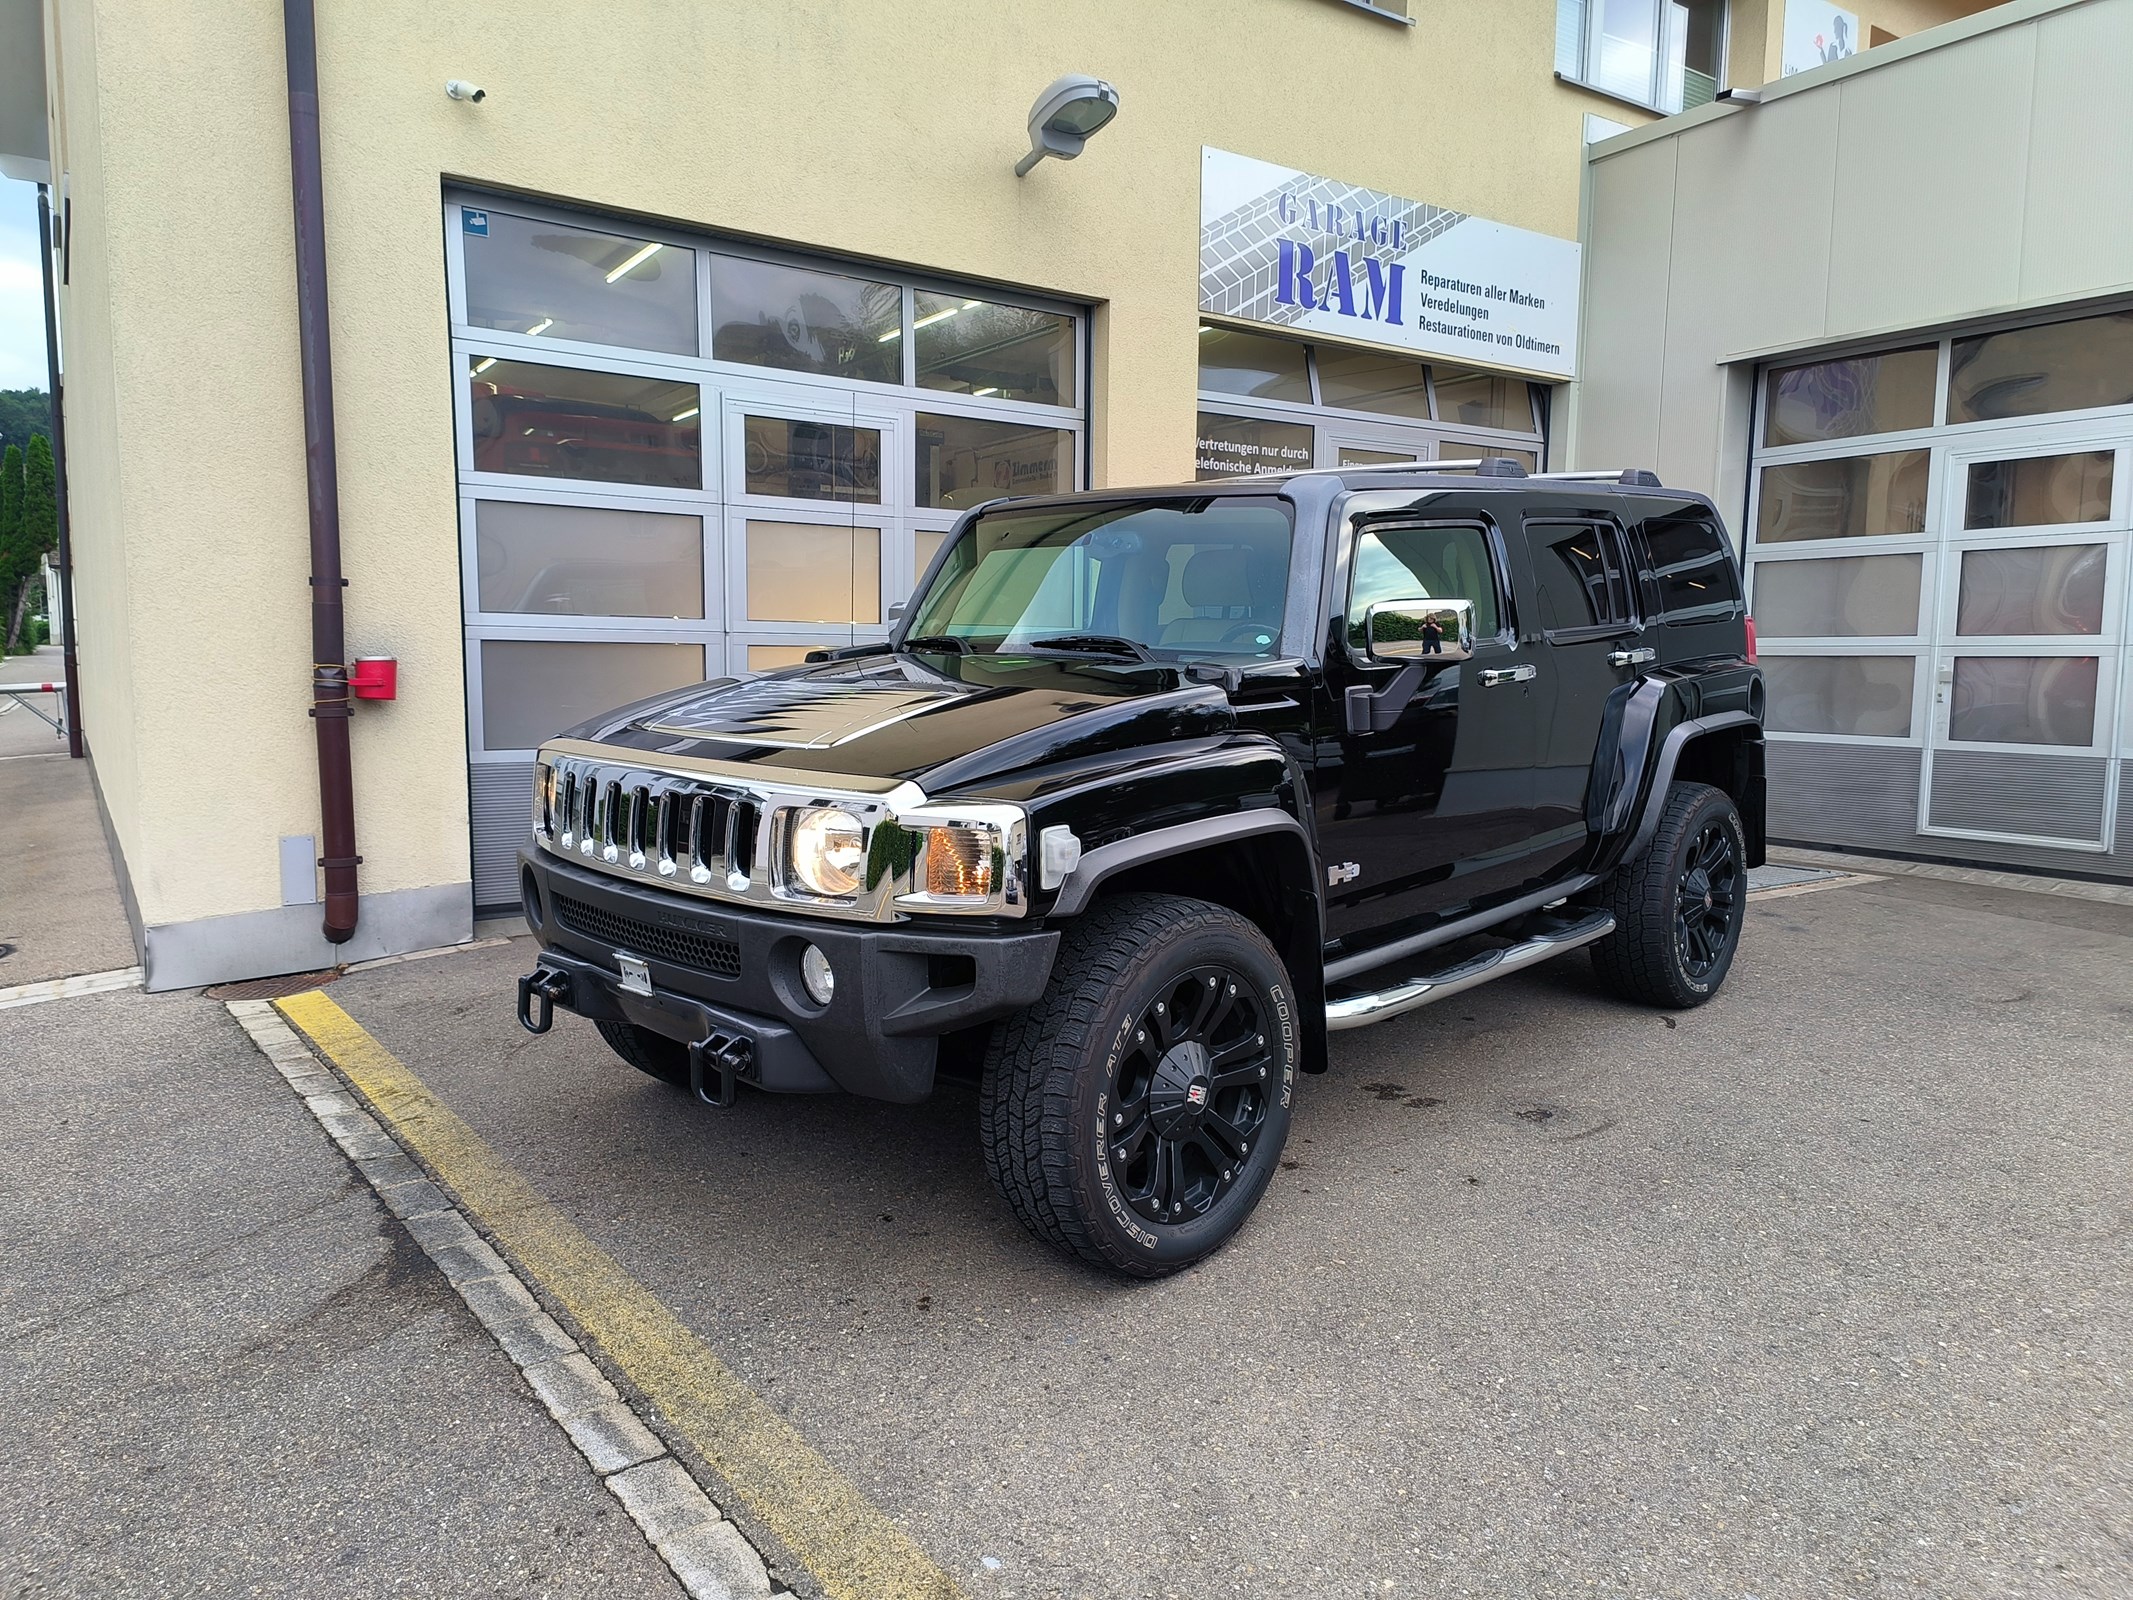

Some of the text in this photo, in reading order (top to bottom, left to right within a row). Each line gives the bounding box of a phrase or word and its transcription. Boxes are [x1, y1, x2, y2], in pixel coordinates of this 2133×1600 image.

[1278, 192, 1407, 251] GARAGE
[1274, 237, 1406, 326] RAM
[1420, 269, 1545, 310] Reparaturen aller Marken
[1420, 292, 1489, 321] Veredelungen
[1418, 315, 1560, 355] Restaurationen von Oldtimern
[1195, 456, 1252, 473] elefonische
[1261, 446, 1279, 457] nur
[1281, 446, 1309, 460] durch
[1269, 984, 1294, 1109] COOPER
[1095, 1013, 1159, 1250] DISCOVERER AT3
